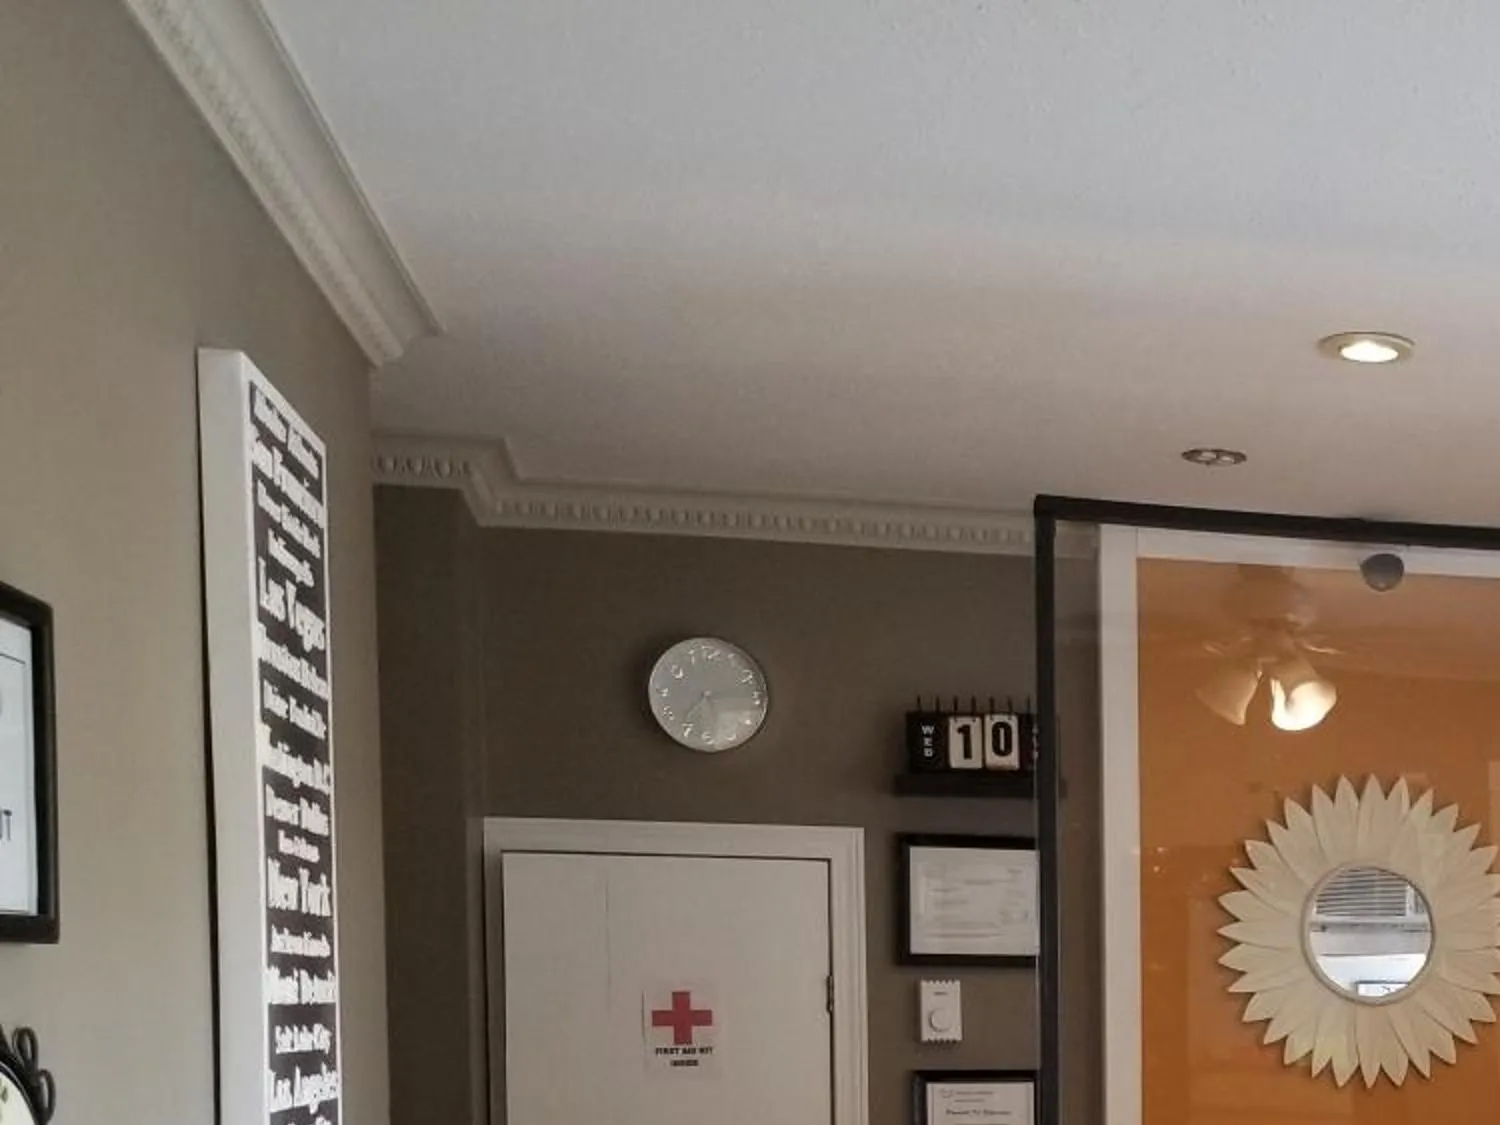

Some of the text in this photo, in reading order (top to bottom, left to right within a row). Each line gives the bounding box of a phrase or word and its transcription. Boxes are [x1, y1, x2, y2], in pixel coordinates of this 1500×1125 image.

[921, 723, 935, 758] WED
[957, 720, 1013, 761] 10
[655, 1047, 680, 1055] FIRST
[682, 1047, 697, 1055] AID
